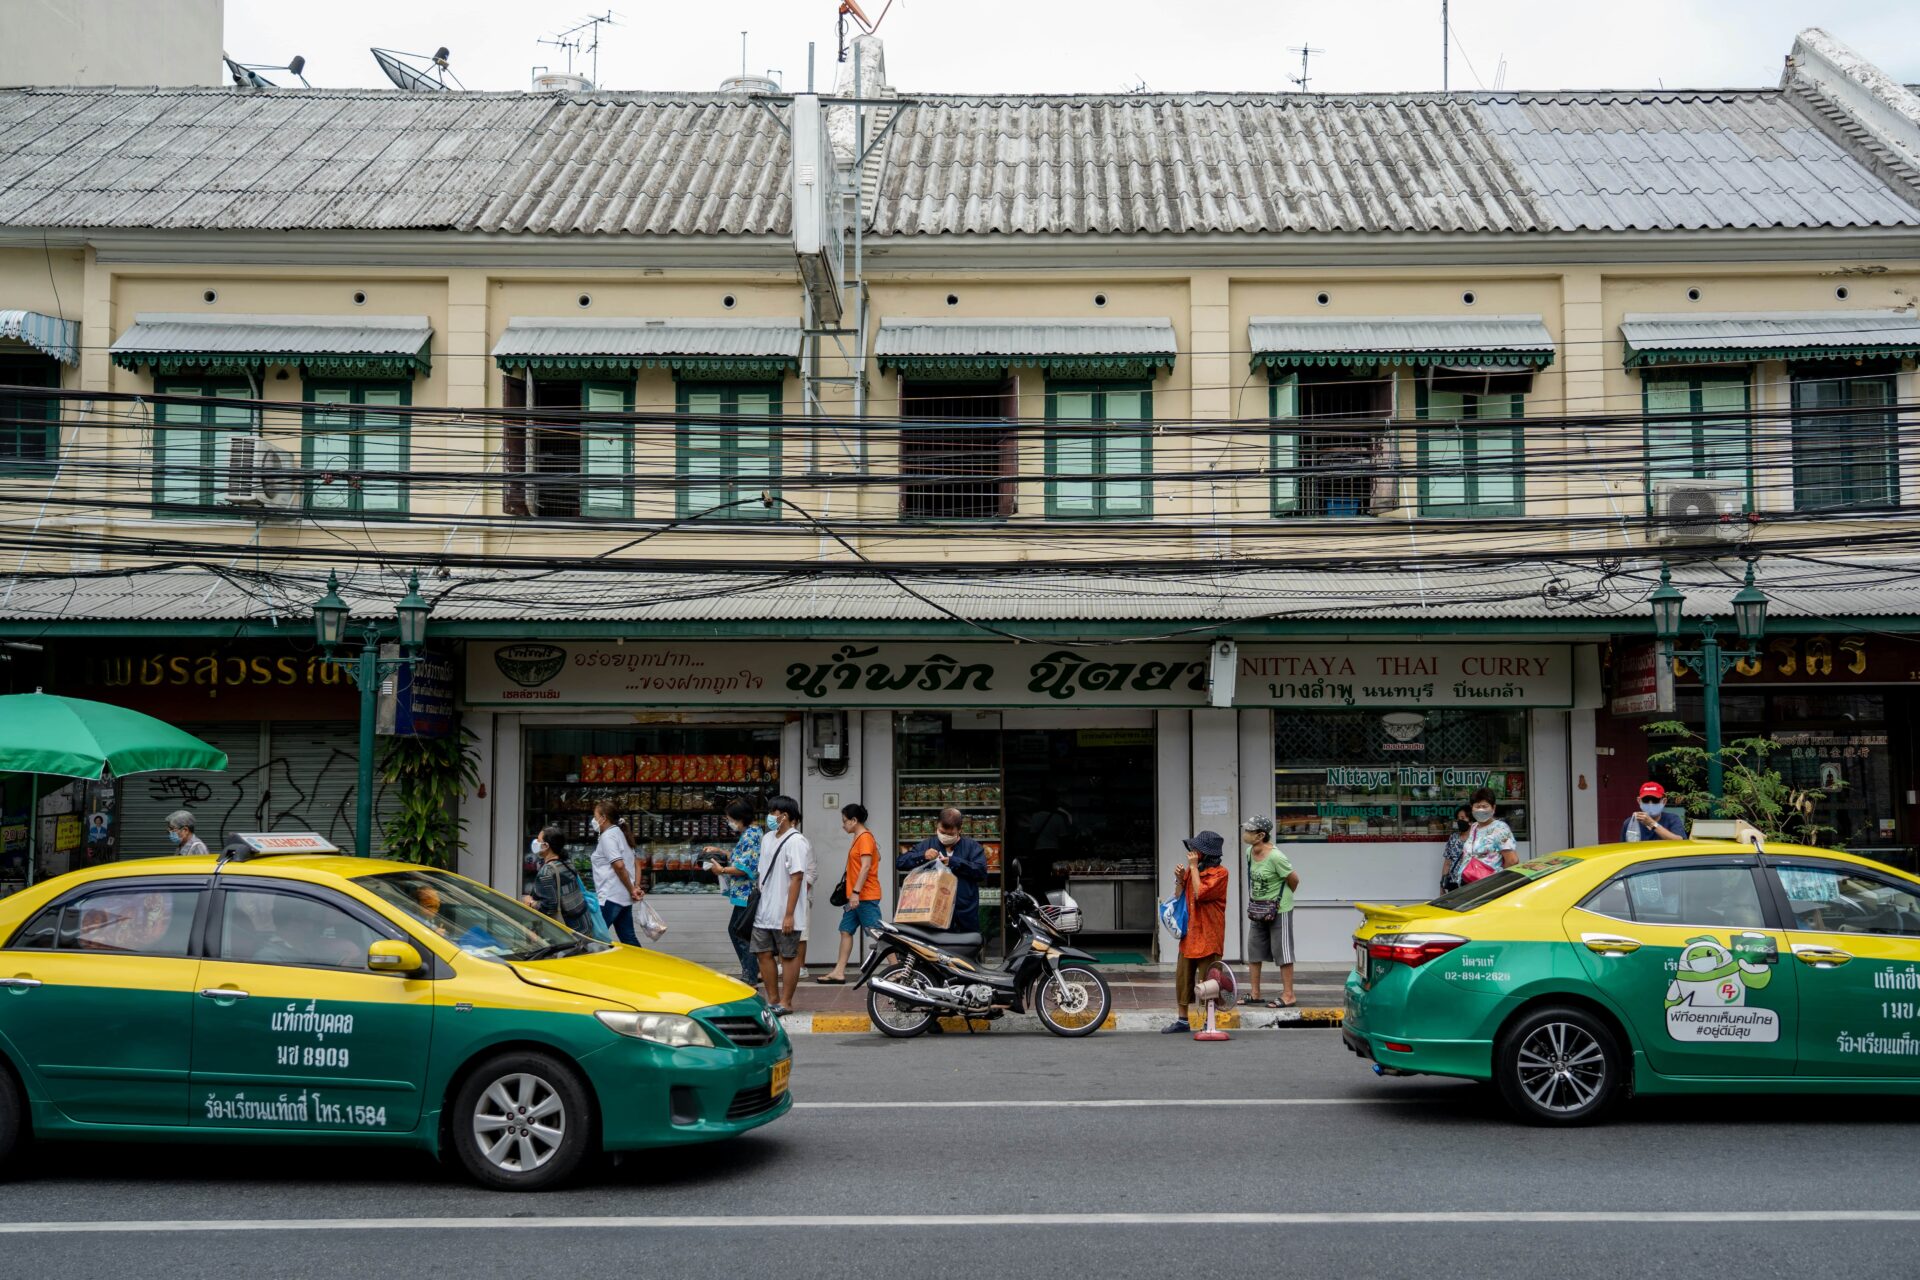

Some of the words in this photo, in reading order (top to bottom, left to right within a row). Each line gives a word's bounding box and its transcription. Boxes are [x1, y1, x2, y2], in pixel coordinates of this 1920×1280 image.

[786, 645, 995, 698] น้ำพริก
[1027, 651, 1207, 699] นิตยา
[1241, 656, 1356, 676] NITTAYA
[1376, 656, 1439, 675] THAI
[1461, 656, 1550, 676] CURRY
[1268, 678, 1355, 704] บางลำพู
[1362, 683, 1434, 702] นนทบุรี
[1453, 680, 1524, 698] ปิ่นเกล้า
[1327, 767, 1392, 790] Nittaya
[1398, 767, 1435, 786] Thai
[1442, 769, 1490, 788] Curry
[1874, 964, 1920, 990] แท็กซี่
[1721, 984, 1736, 999] PT
[271, 999, 354, 1042] แท็กซี่บุคคล
[1836, 1030, 1920, 1056] ร้องเรียนแท็ก
[303, 1047, 349, 1068] 8909
[204, 1090, 308, 1122] ร้องเรียนแท็กซี่
[311, 1093, 387, 1127] โทร.1584
